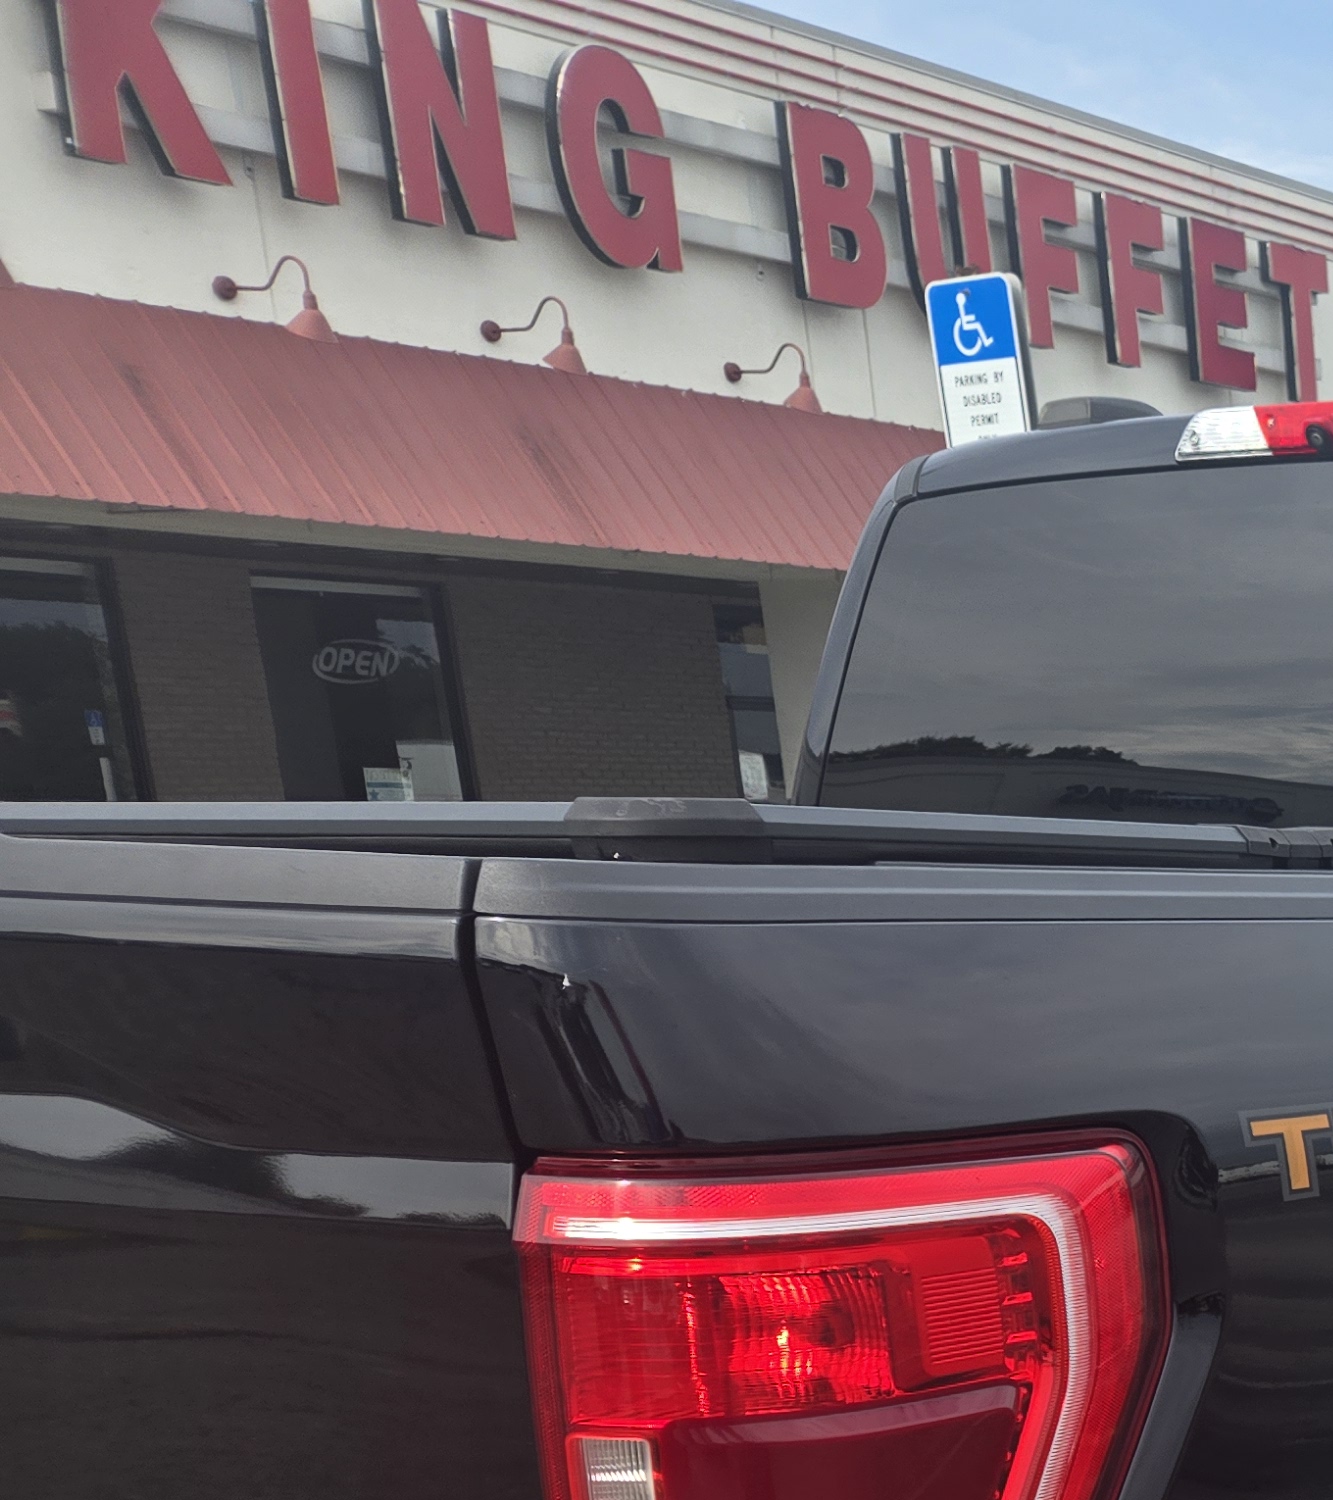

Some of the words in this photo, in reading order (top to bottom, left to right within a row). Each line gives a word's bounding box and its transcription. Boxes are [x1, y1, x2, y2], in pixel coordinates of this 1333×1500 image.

[54, 0, 684, 272] KING
[776, 101, 1328, 401] BUFFET
[955, 373, 988, 387] PARKING
[994, 371, 1004, 383] BY
[963, 392, 1002, 407] DISABLED
[971, 413, 999, 426] PERMIT
[318, 646, 390, 677] OPEN
